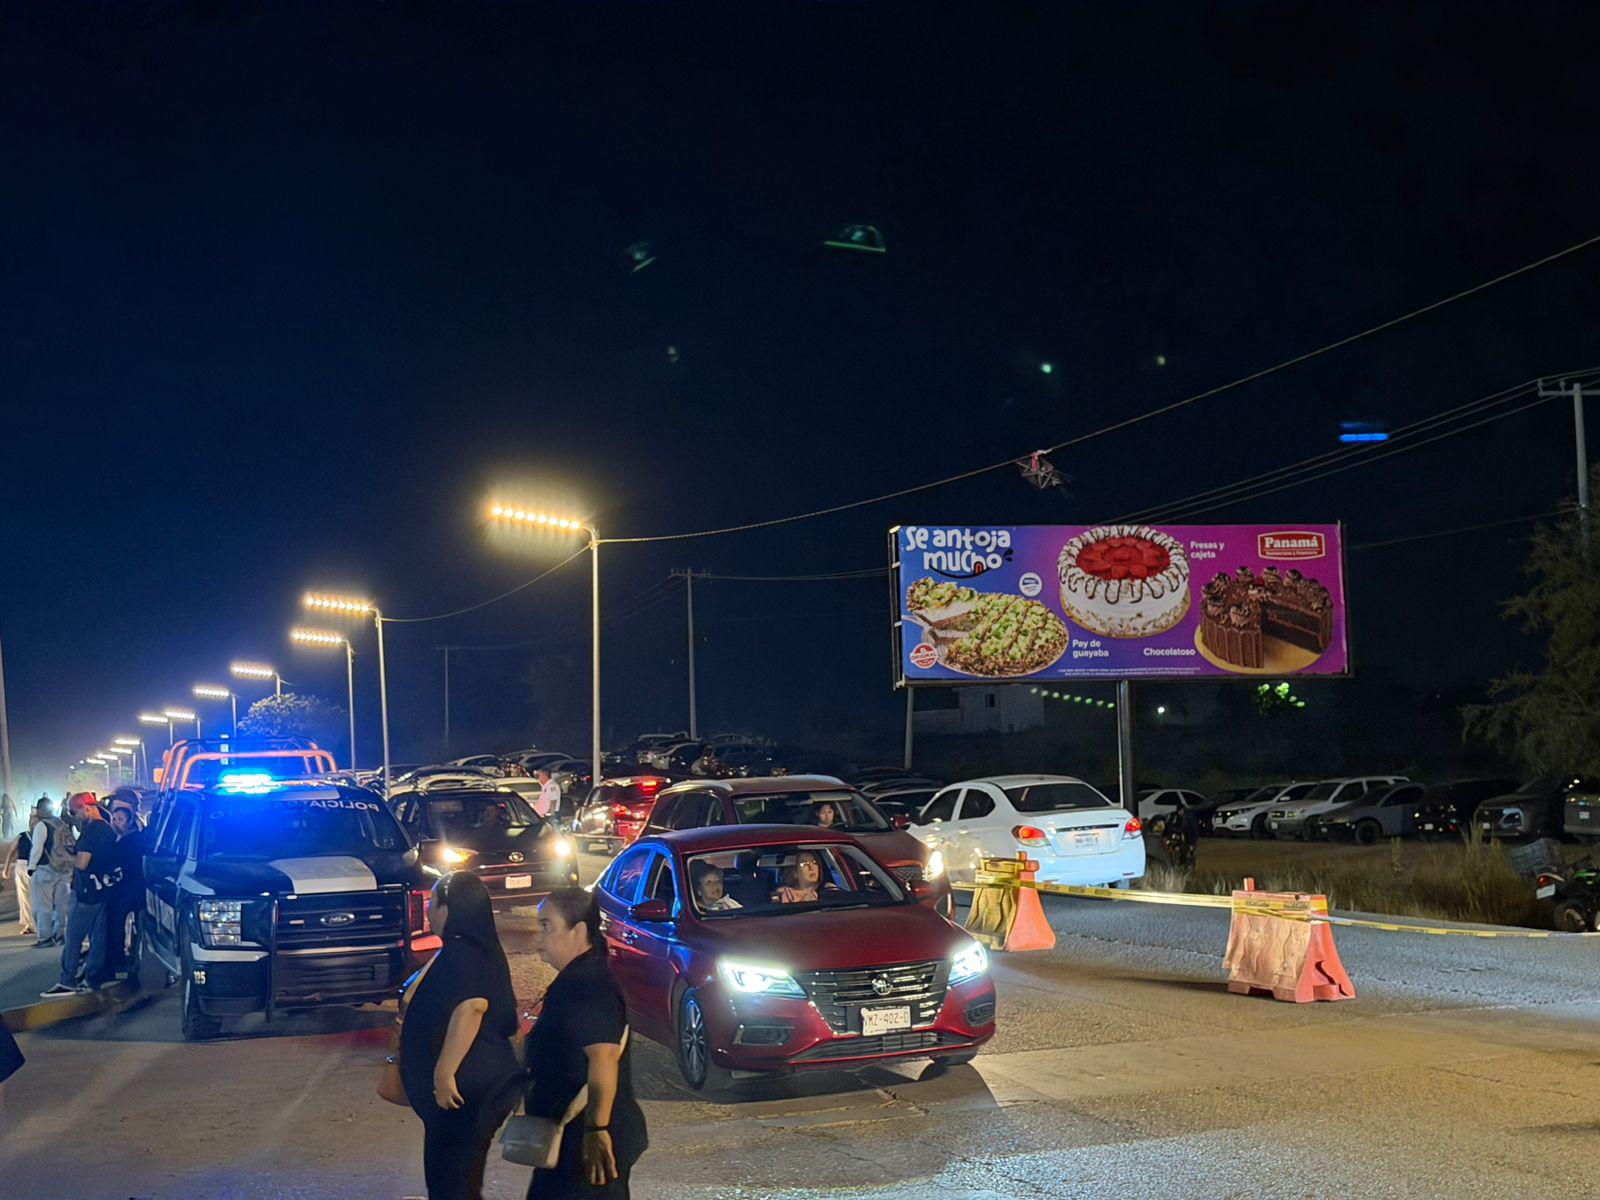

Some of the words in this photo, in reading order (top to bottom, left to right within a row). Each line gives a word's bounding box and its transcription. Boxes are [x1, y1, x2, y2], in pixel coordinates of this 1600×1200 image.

[906, 526, 929, 551] Se
[932, 528, 1011, 553] antoja
[1264, 536, 1318, 548] Panamá
[1190, 541, 1218, 549] Fresas
[1218, 542, 1225, 550] y
[1190, 550, 1216, 560] cajeta
[1072, 639, 1089, 650] Pay
[1090, 639, 1101, 648] de
[1072, 649, 1109, 659] guayaba
[1143, 647, 1196, 656] Chocolatoso
